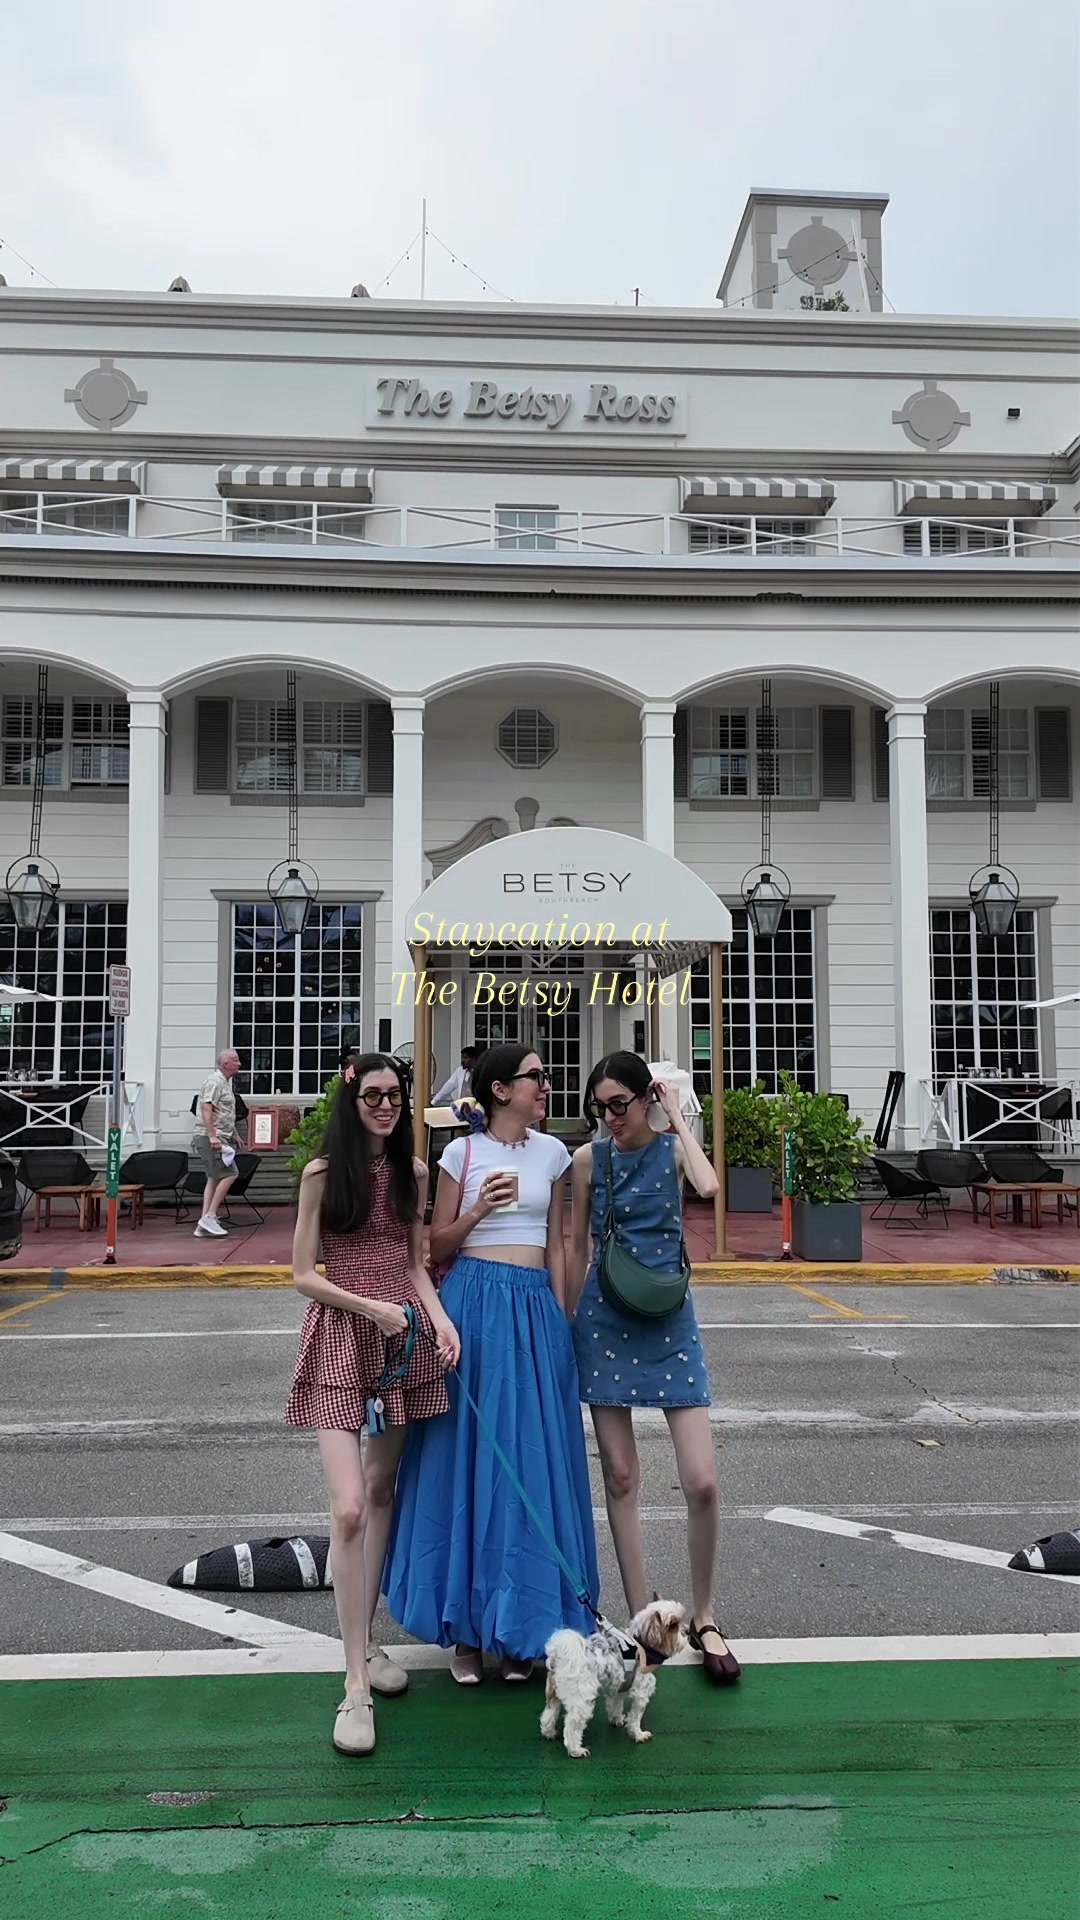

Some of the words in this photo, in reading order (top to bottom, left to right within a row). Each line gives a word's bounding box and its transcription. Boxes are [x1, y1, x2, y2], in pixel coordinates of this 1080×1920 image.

[376, 377, 453, 418] The
[463, 380, 574, 430] Betsy
[582, 383, 678, 424] Ross
[503, 872, 632, 893] BETSY
[109, 1132, 118, 1180] VALET
